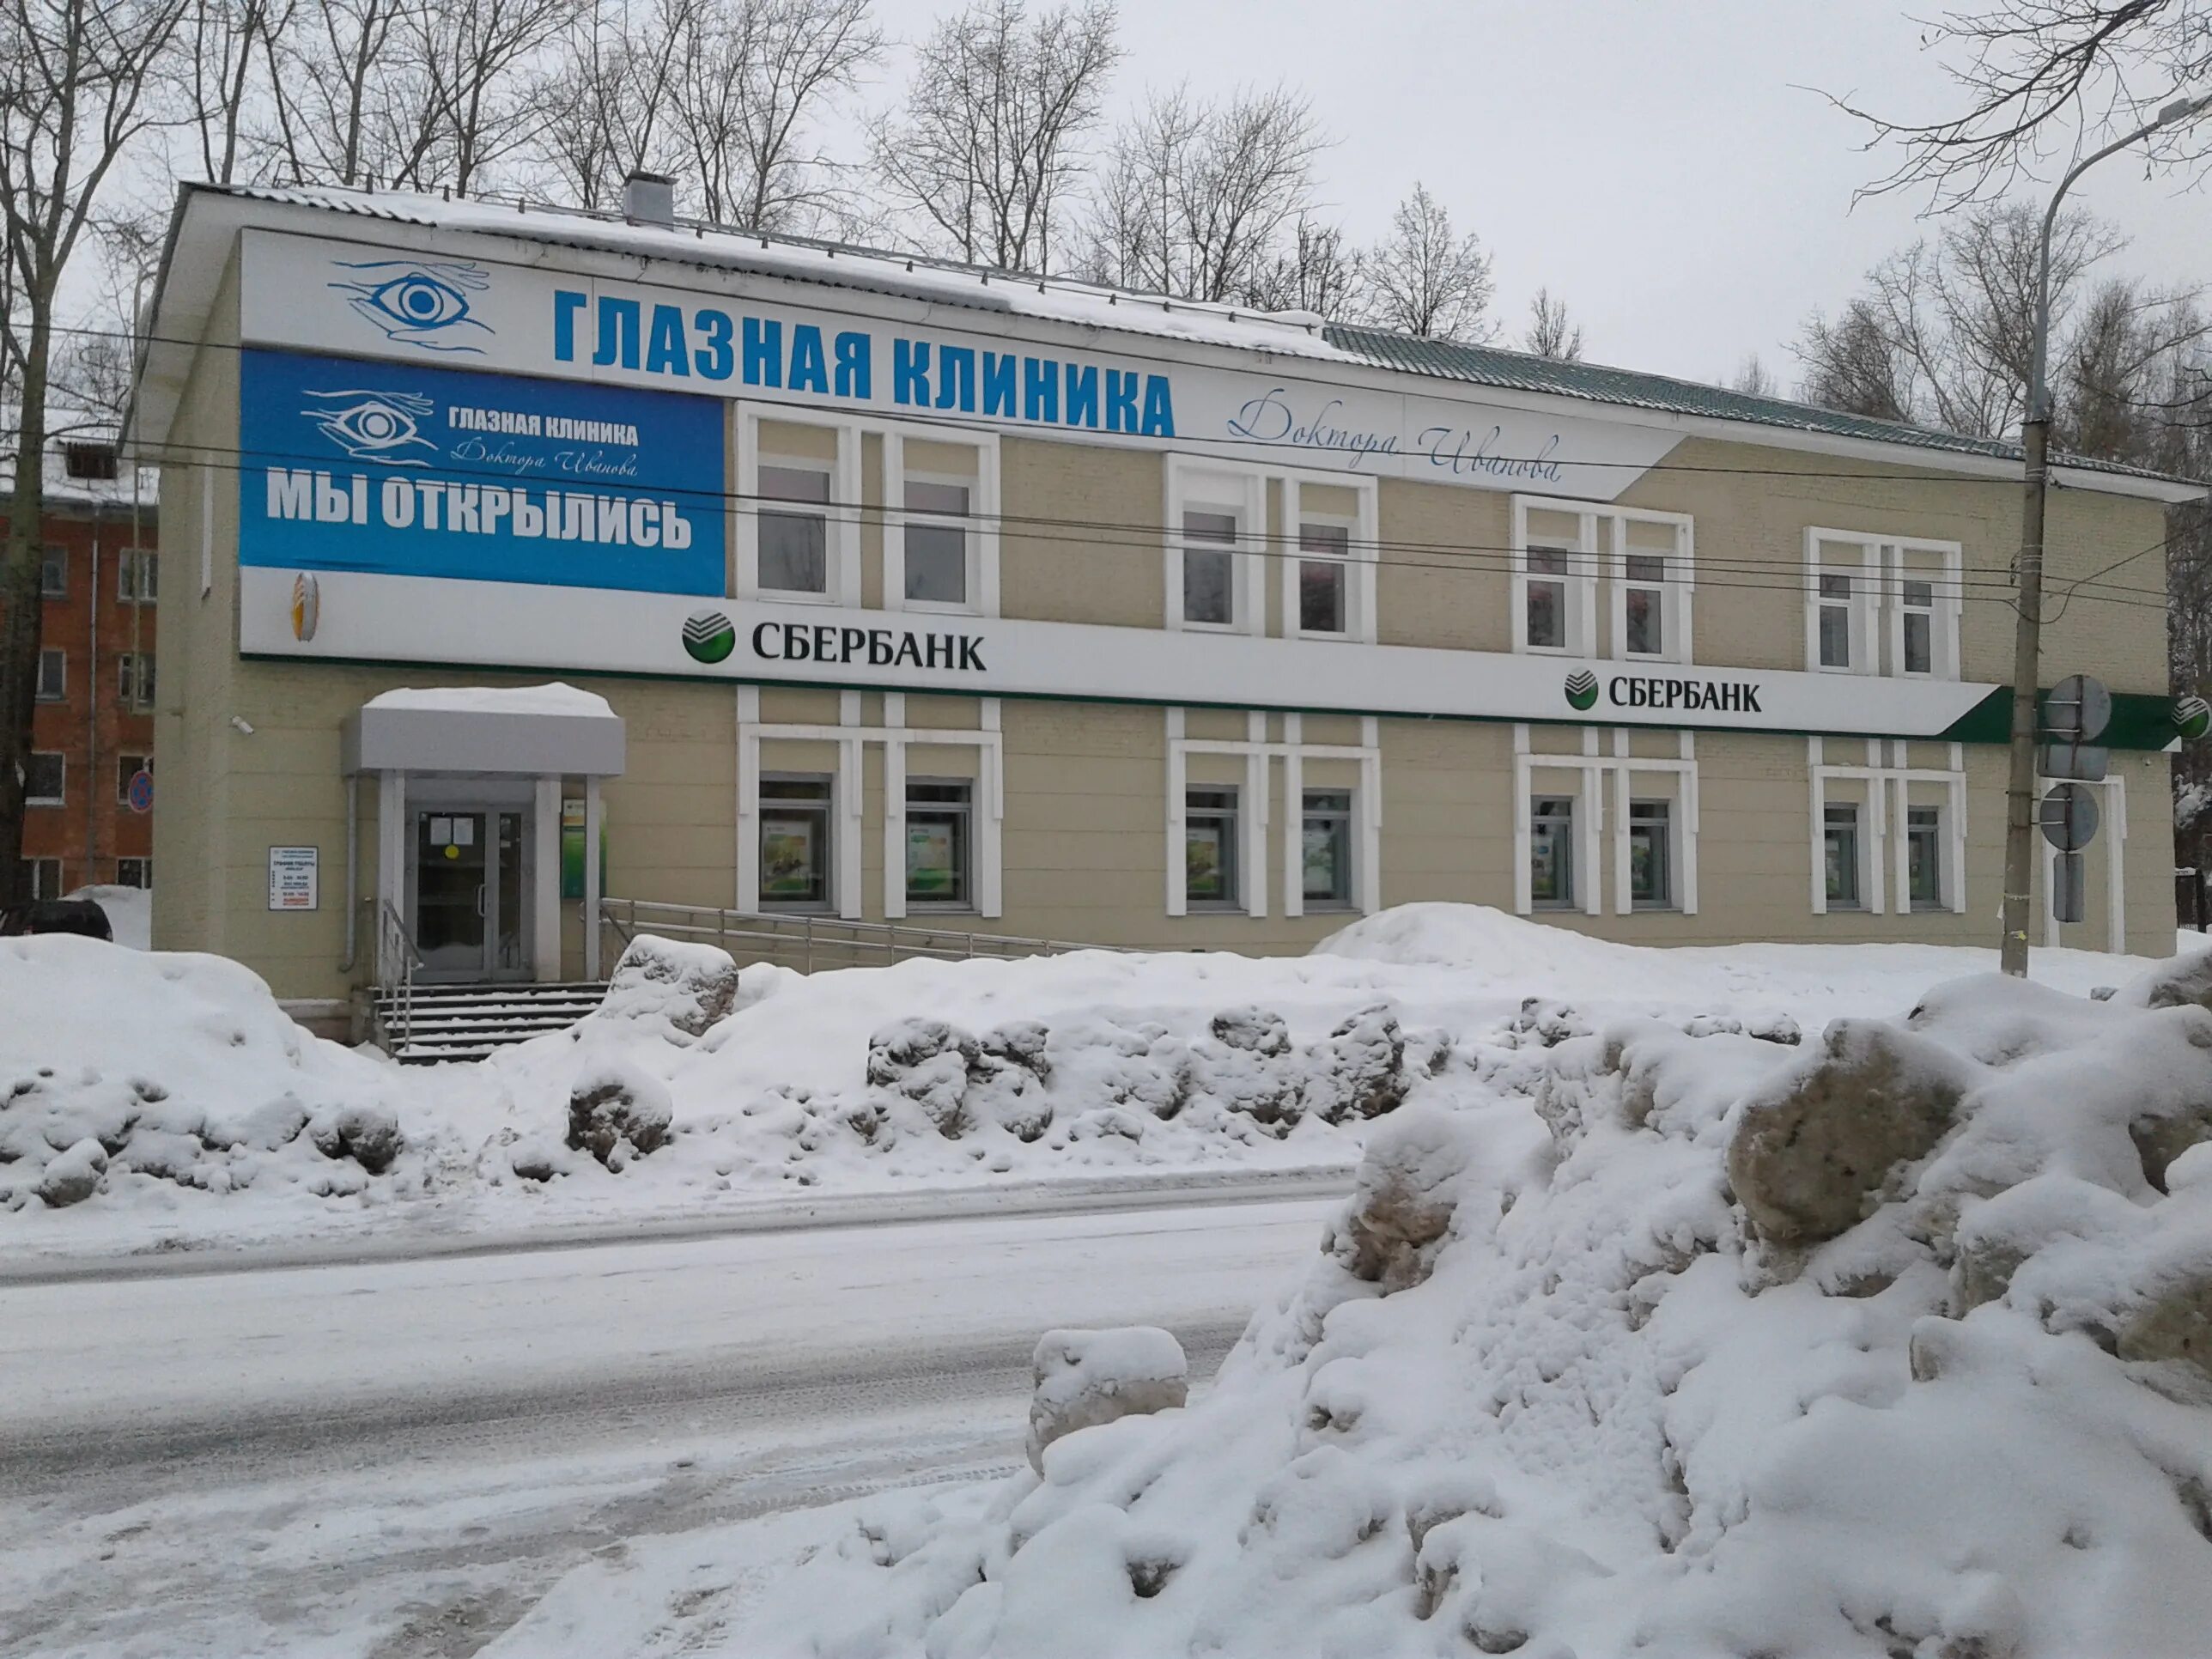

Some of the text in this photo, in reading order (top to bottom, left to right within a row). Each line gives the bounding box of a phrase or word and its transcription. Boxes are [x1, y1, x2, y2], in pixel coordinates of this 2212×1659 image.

[555, 291, 1562, 483] ГЛАЗНАЯ КЛИНИКА Доктора Иванова
[448, 406, 639, 447] ГЛАЗНАЯ КЛИНИКА
[450, 435, 638, 477] Доктора Иванова
[266, 470, 692, 550] МЫ ОТКРЫЛИСЬ
[751, 620, 987, 672] СБЕРБАНК
[1608, 675, 1763, 714] СБЕРБАНК
